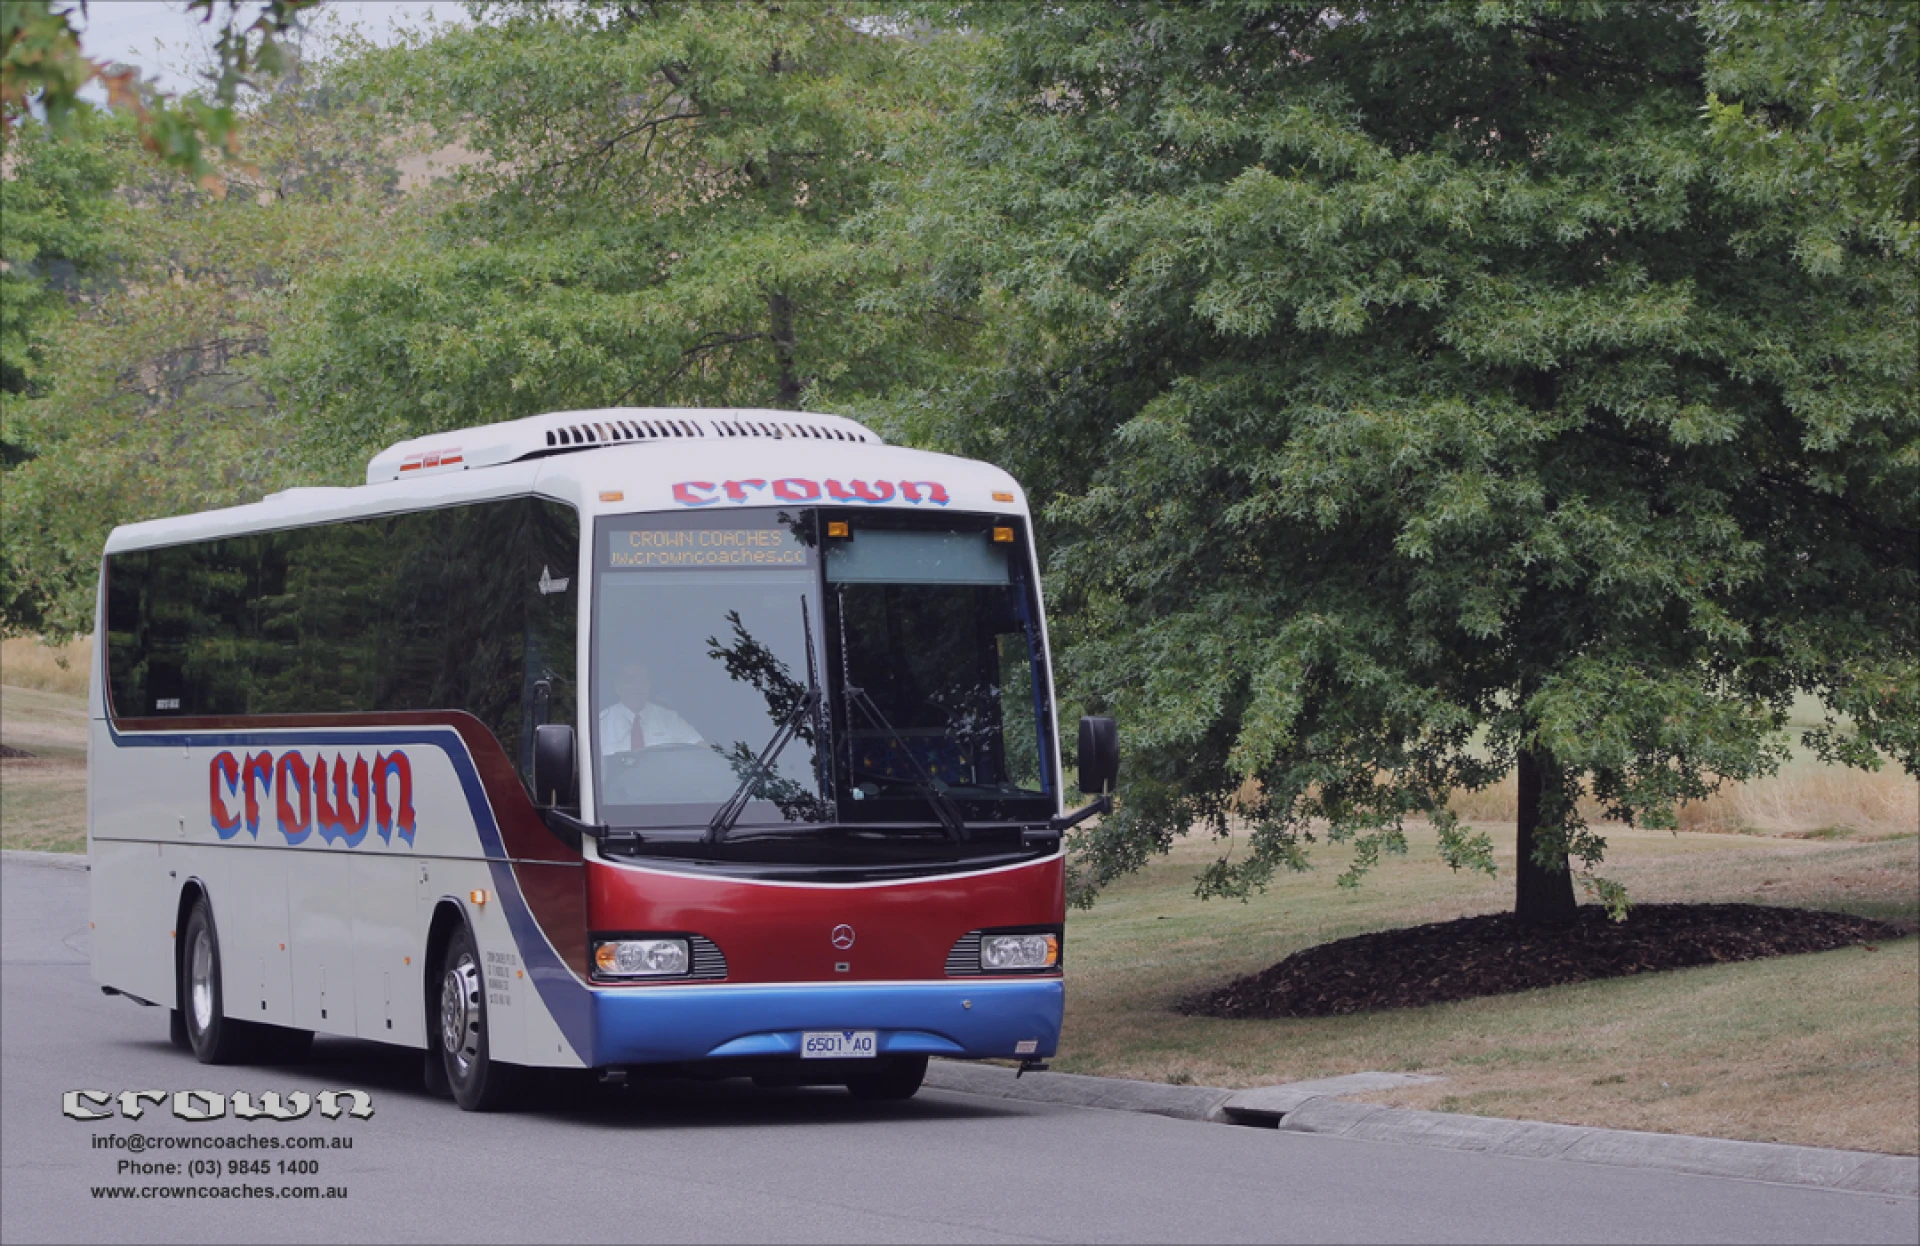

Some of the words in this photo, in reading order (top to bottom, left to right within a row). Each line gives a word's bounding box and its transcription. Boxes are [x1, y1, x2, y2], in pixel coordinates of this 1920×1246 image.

[672, 478, 950, 507] crown
[629, 530, 693, 548] CROWN
[700, 530, 783, 547] COACHES
[209, 749, 417, 850] crown
[806, 1037, 842, 1052] 6501
